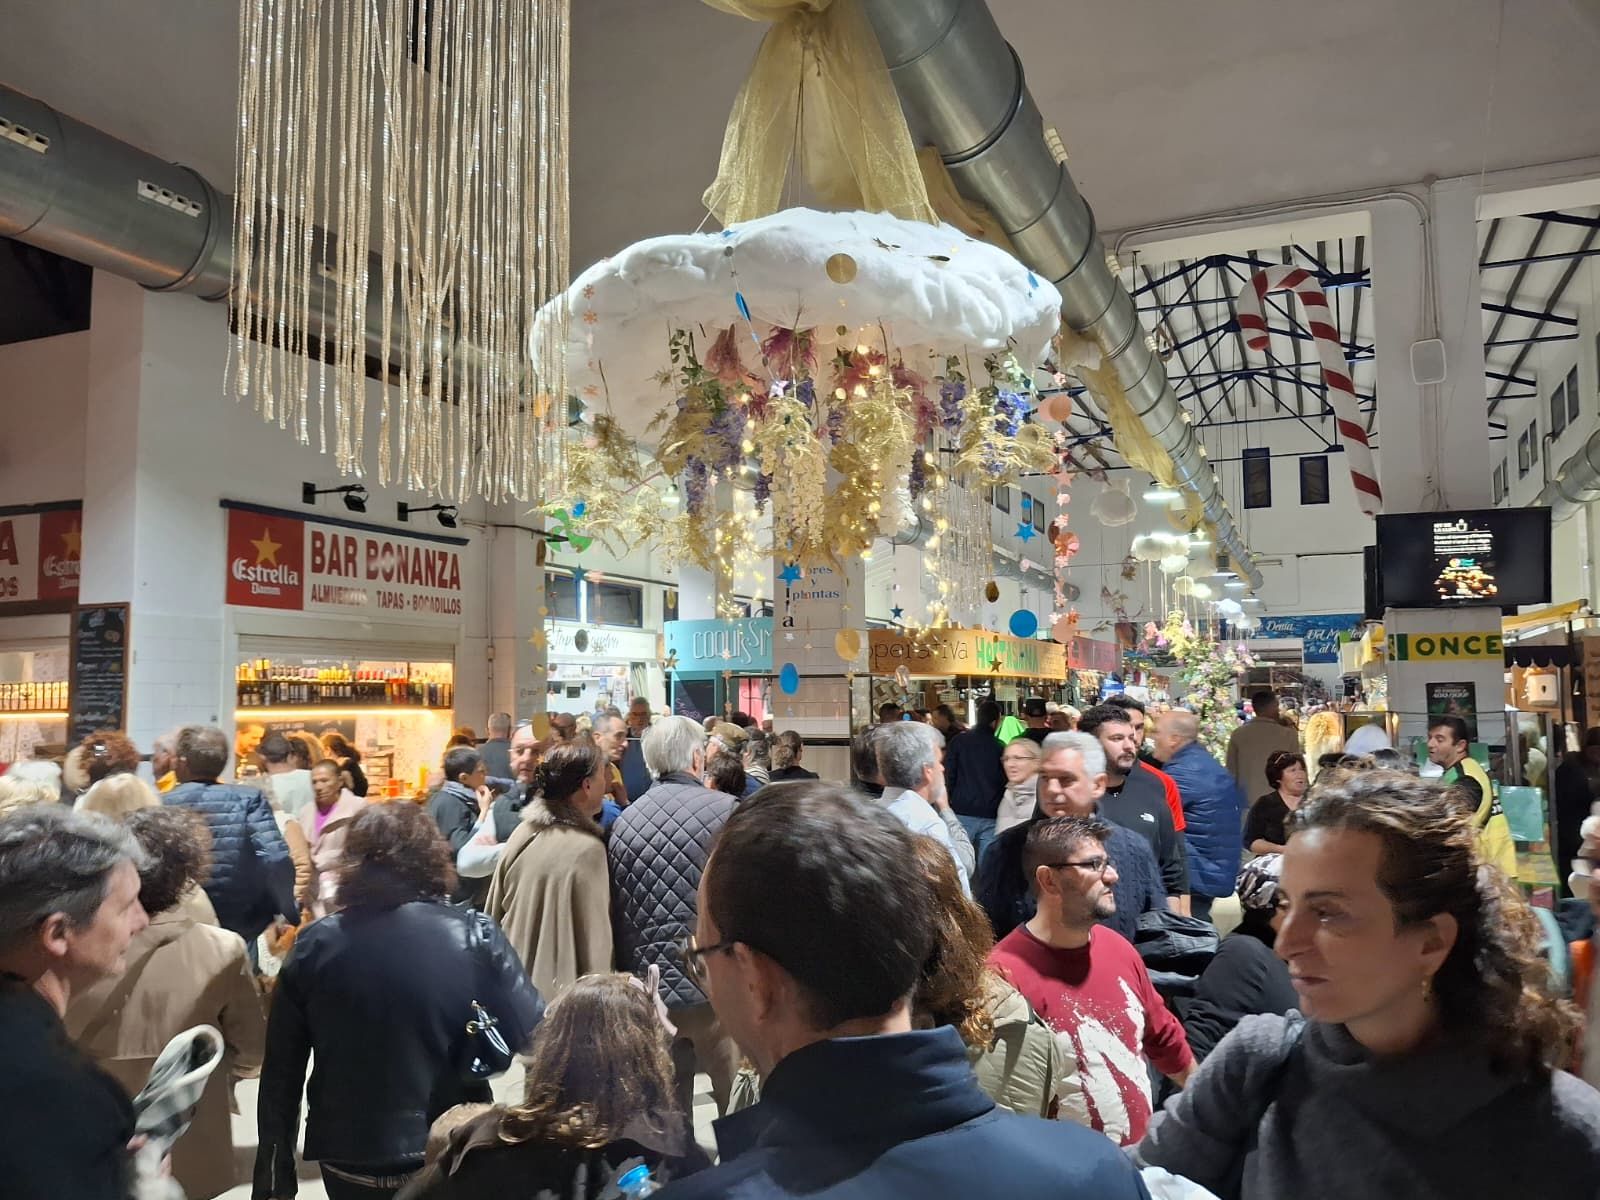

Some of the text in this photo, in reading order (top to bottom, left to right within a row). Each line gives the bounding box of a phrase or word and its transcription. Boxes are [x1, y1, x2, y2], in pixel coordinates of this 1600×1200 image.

[232, 557, 299, 585] Estrella
[311, 530, 461, 591] BAR BONANZA
[376, 590, 405, 610] TAPAS
[412, 594, 461, 615] BOCADILLOS
[792, 589, 840, 601] plantas
[1415, 634, 1502, 656] ONCE
